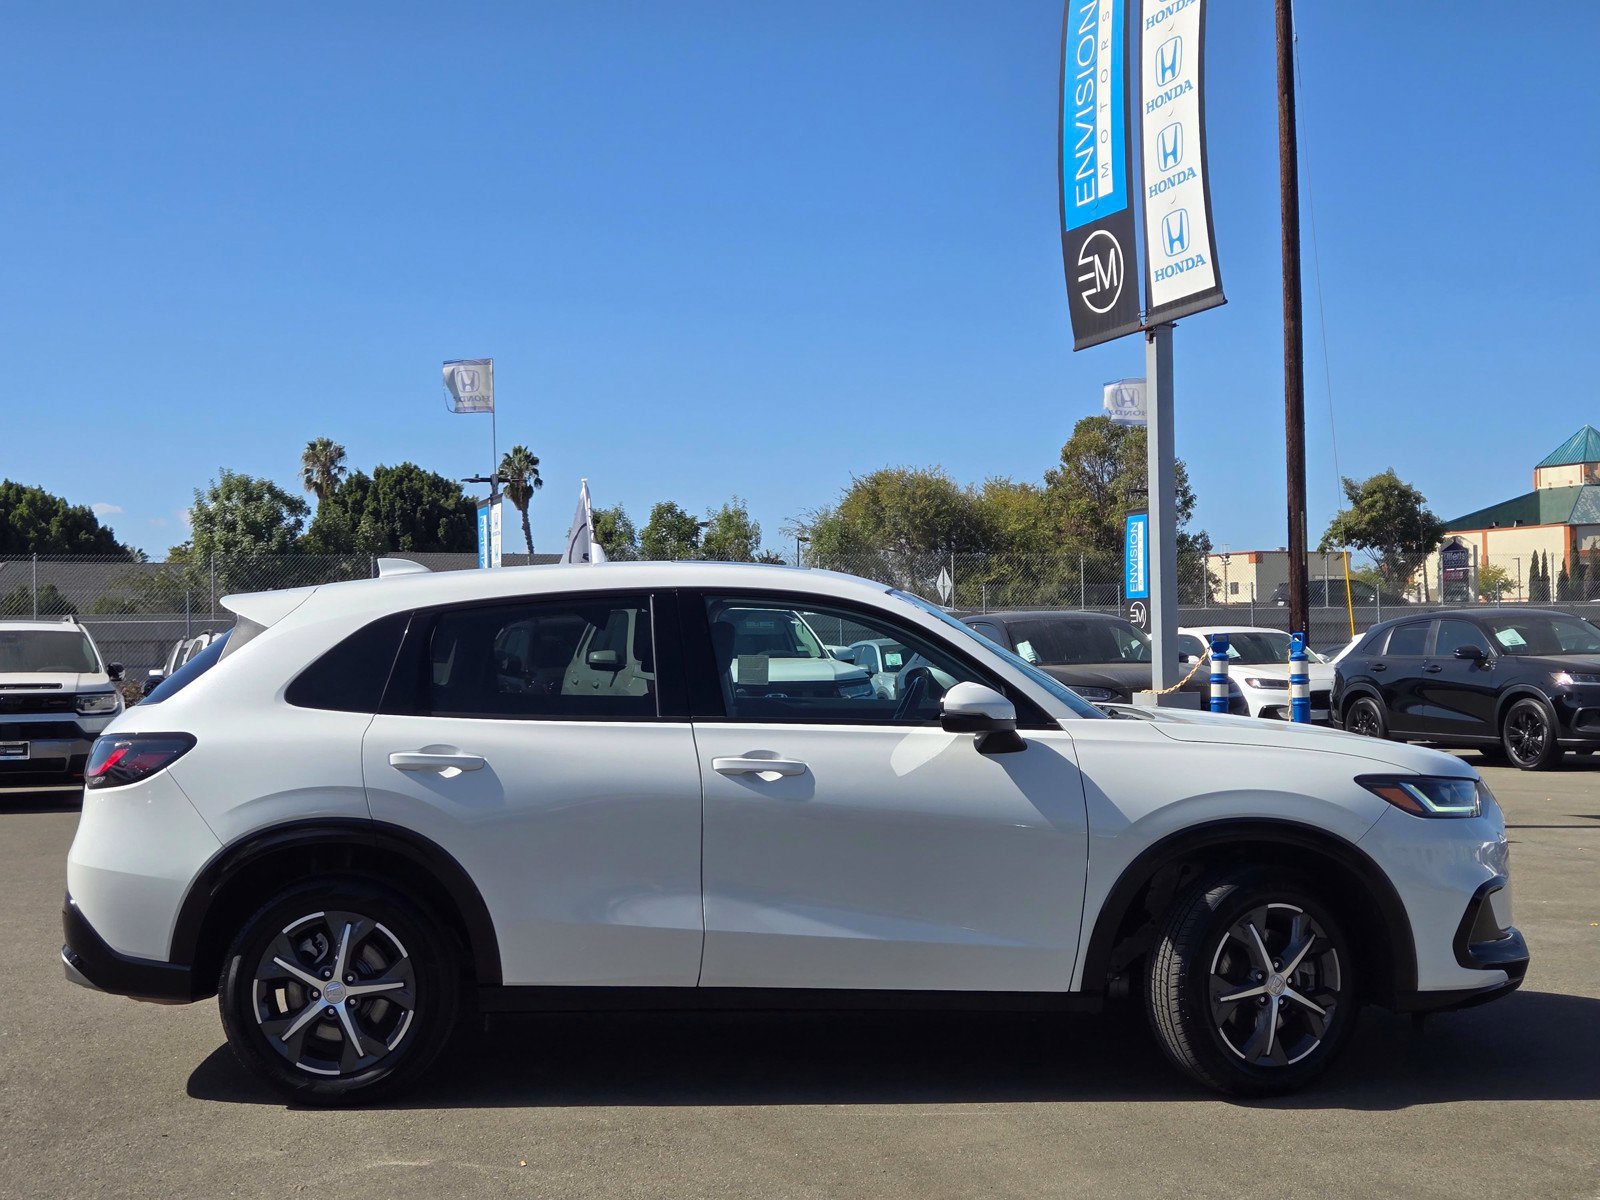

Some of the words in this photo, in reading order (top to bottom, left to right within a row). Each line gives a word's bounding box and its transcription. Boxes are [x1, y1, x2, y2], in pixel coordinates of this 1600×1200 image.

[1076, 0, 1098, 207] ENVISION
[1100, 10, 1110, 179] MOTORS
[1145, 79, 1194, 115] HONDA
[1148, 166, 1197, 199] HONDA
[1154, 253, 1207, 283] HONDA
[1130, 521, 1138, 592] ENVISION
